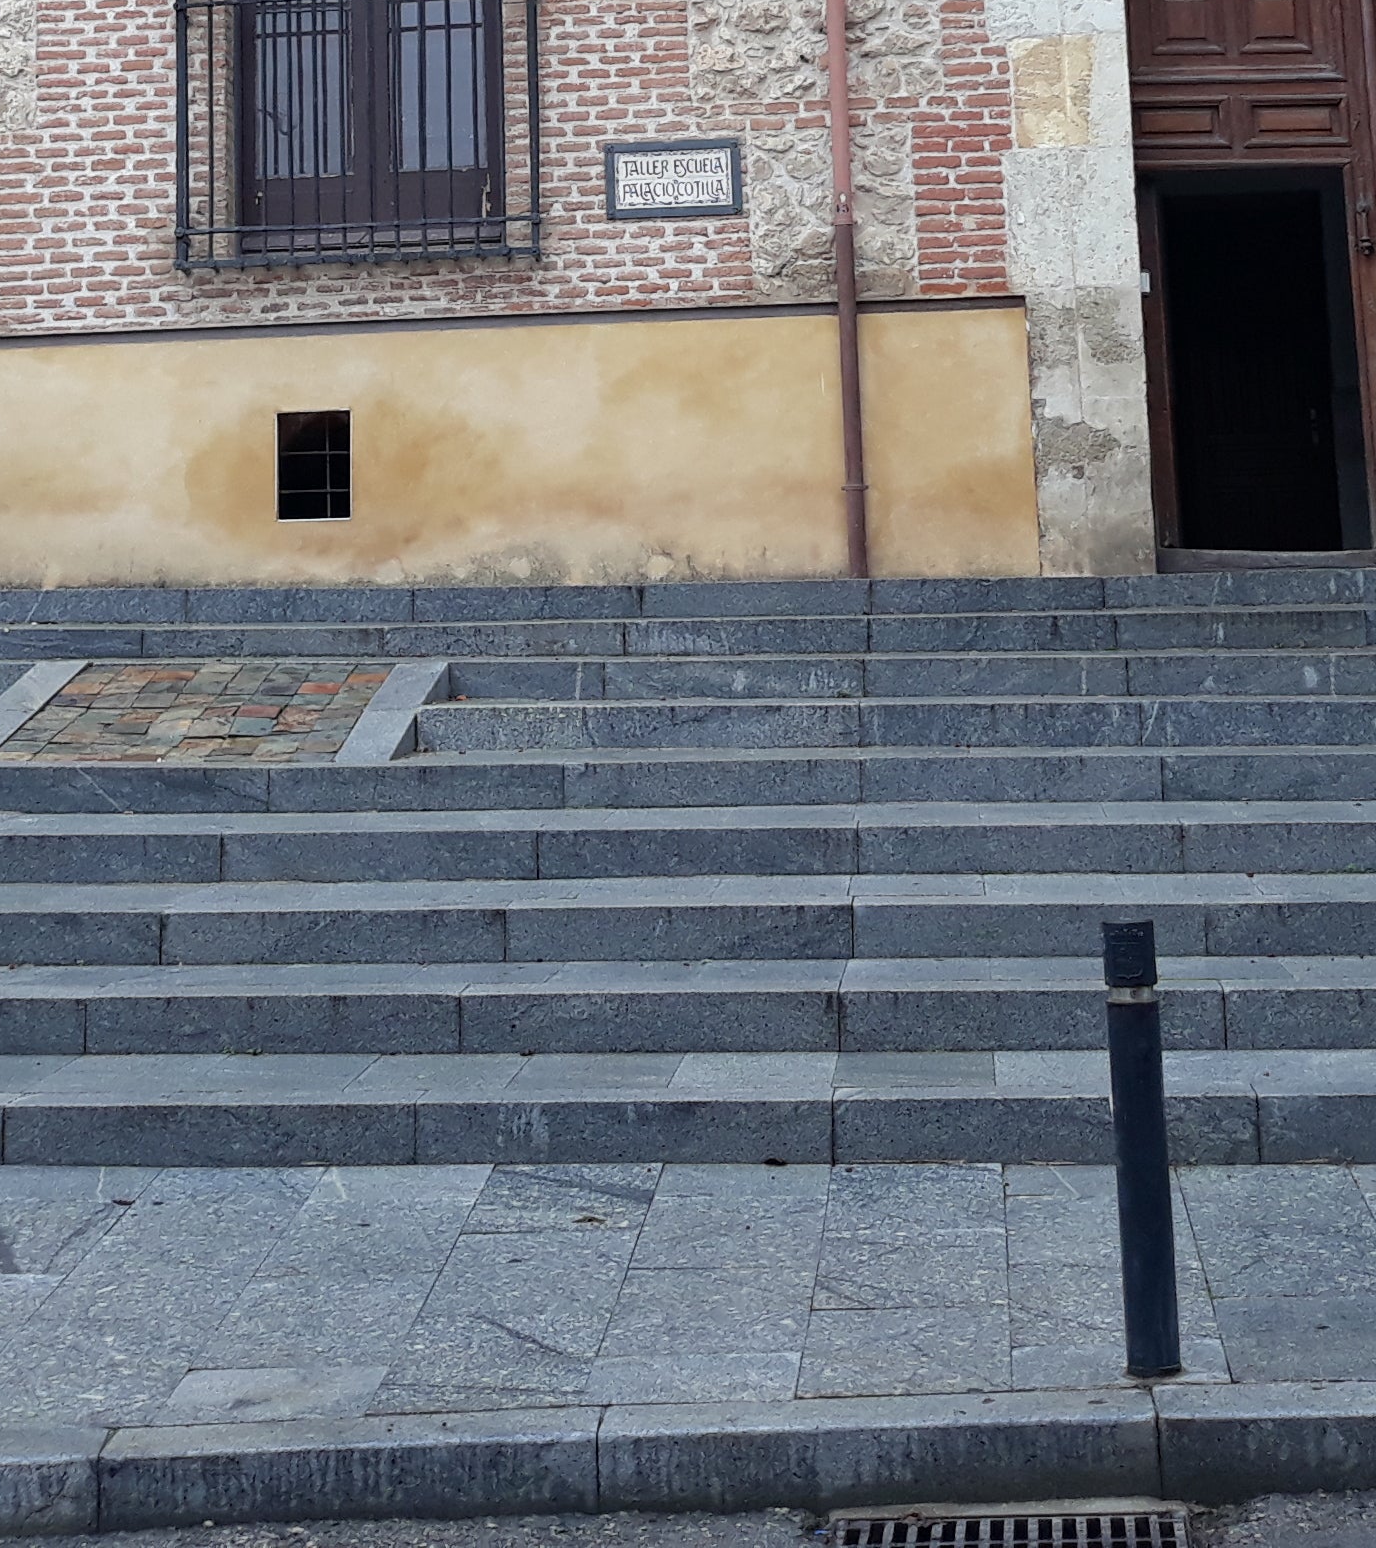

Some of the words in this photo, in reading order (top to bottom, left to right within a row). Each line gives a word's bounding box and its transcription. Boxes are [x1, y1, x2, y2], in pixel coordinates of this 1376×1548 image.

[622, 159, 669, 179] TALLER
[673, 156, 726, 178] ESCUELA
[622, 180, 675, 203] PALACIO
[676, 179, 726, 198] COTILLA
